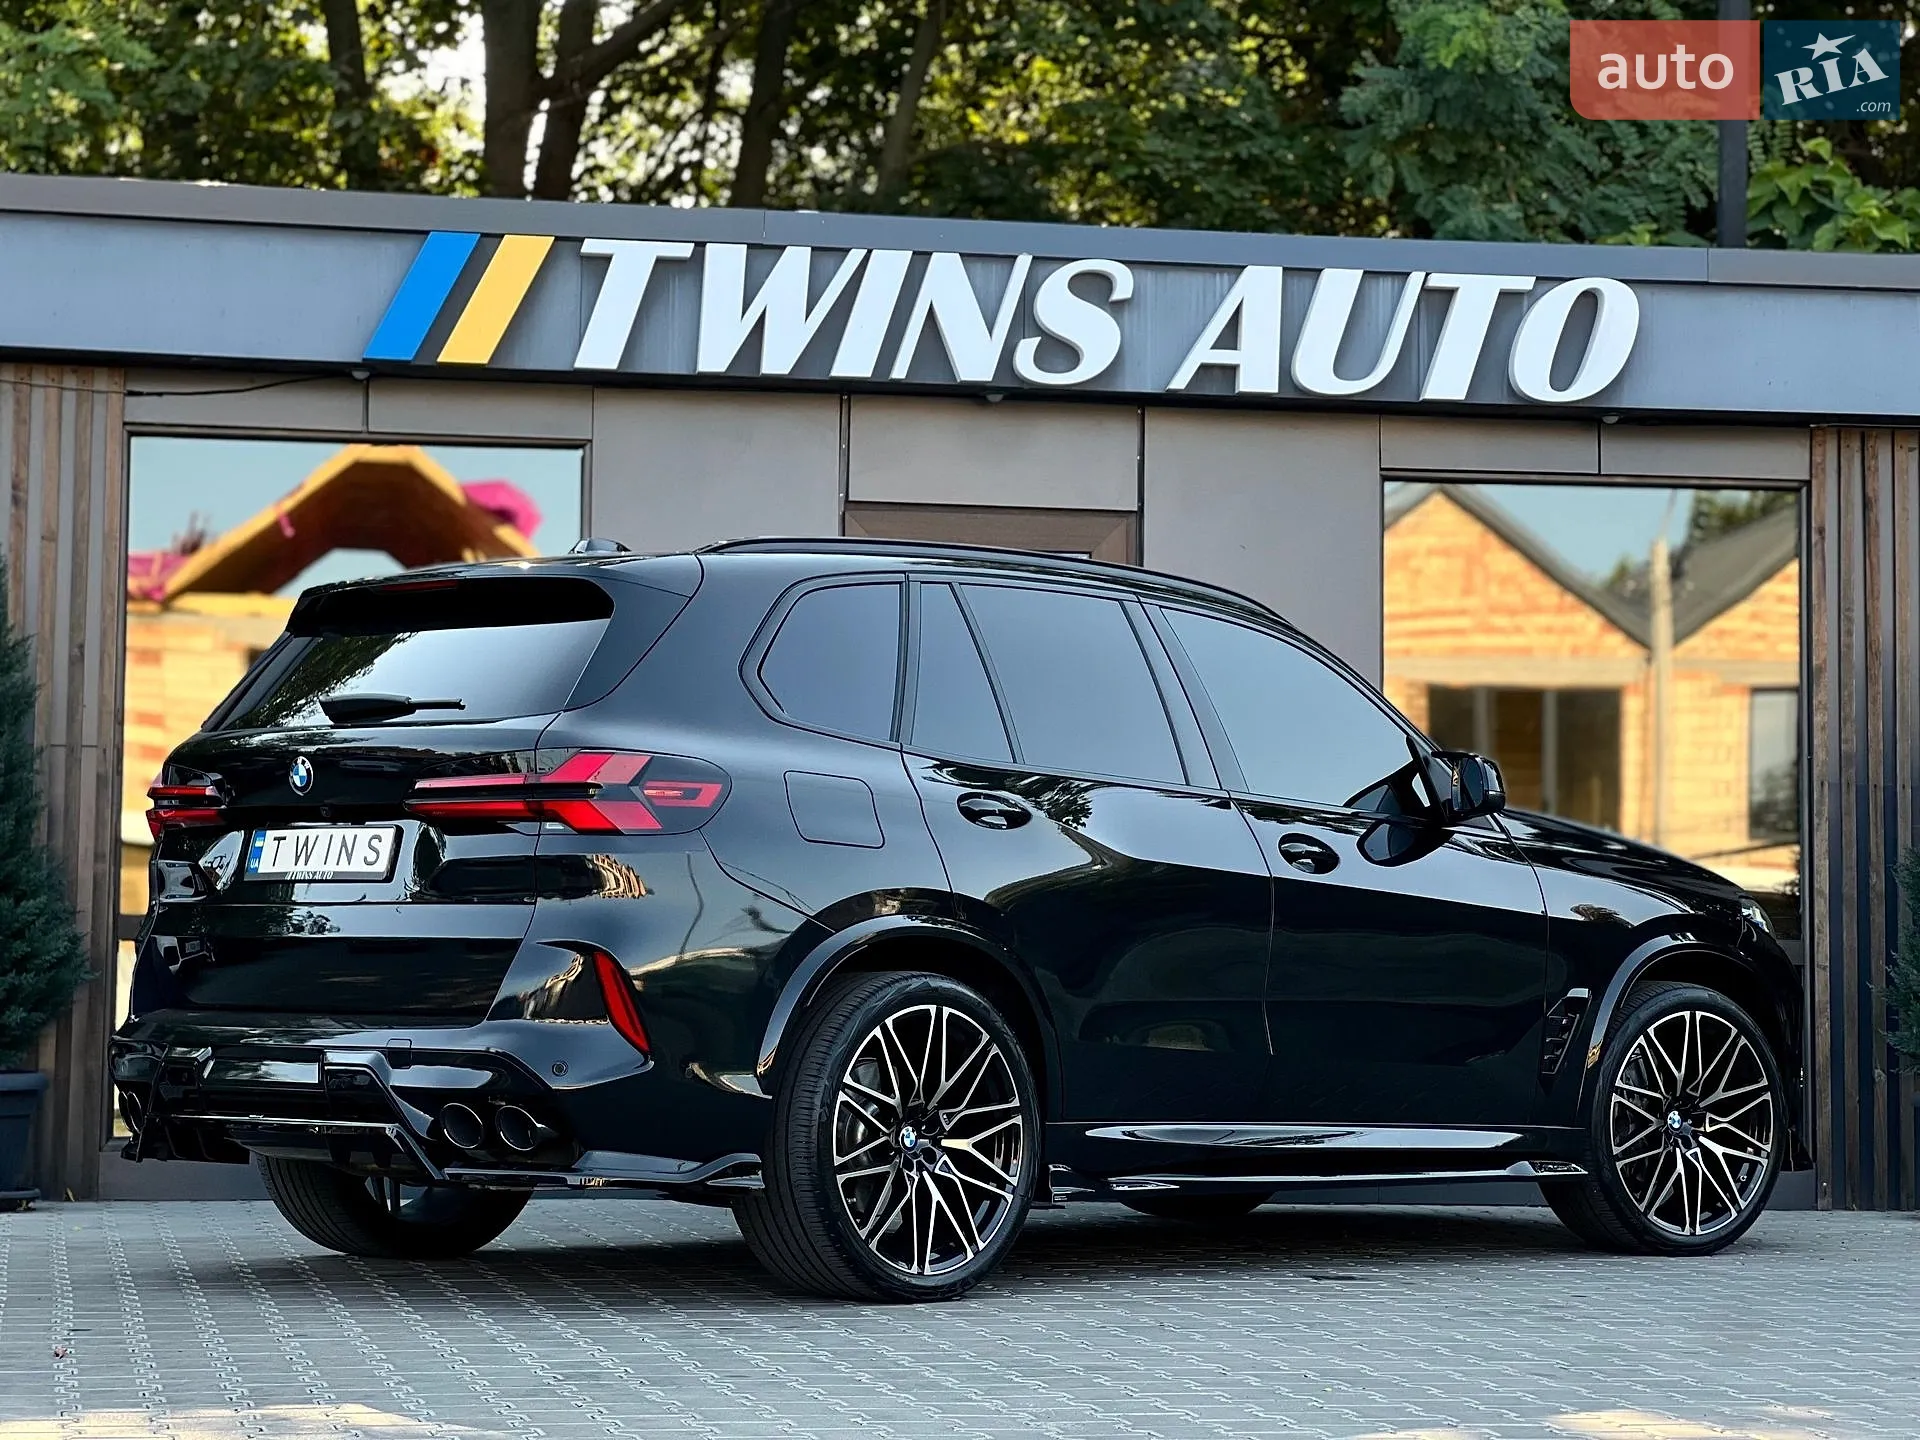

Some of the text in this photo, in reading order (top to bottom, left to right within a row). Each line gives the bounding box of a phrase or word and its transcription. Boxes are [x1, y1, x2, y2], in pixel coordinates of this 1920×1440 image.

[573, 238, 1641, 404] TWINS AUTO
[250, 857, 259, 869] UA
[272, 834, 383, 867] TWINS
